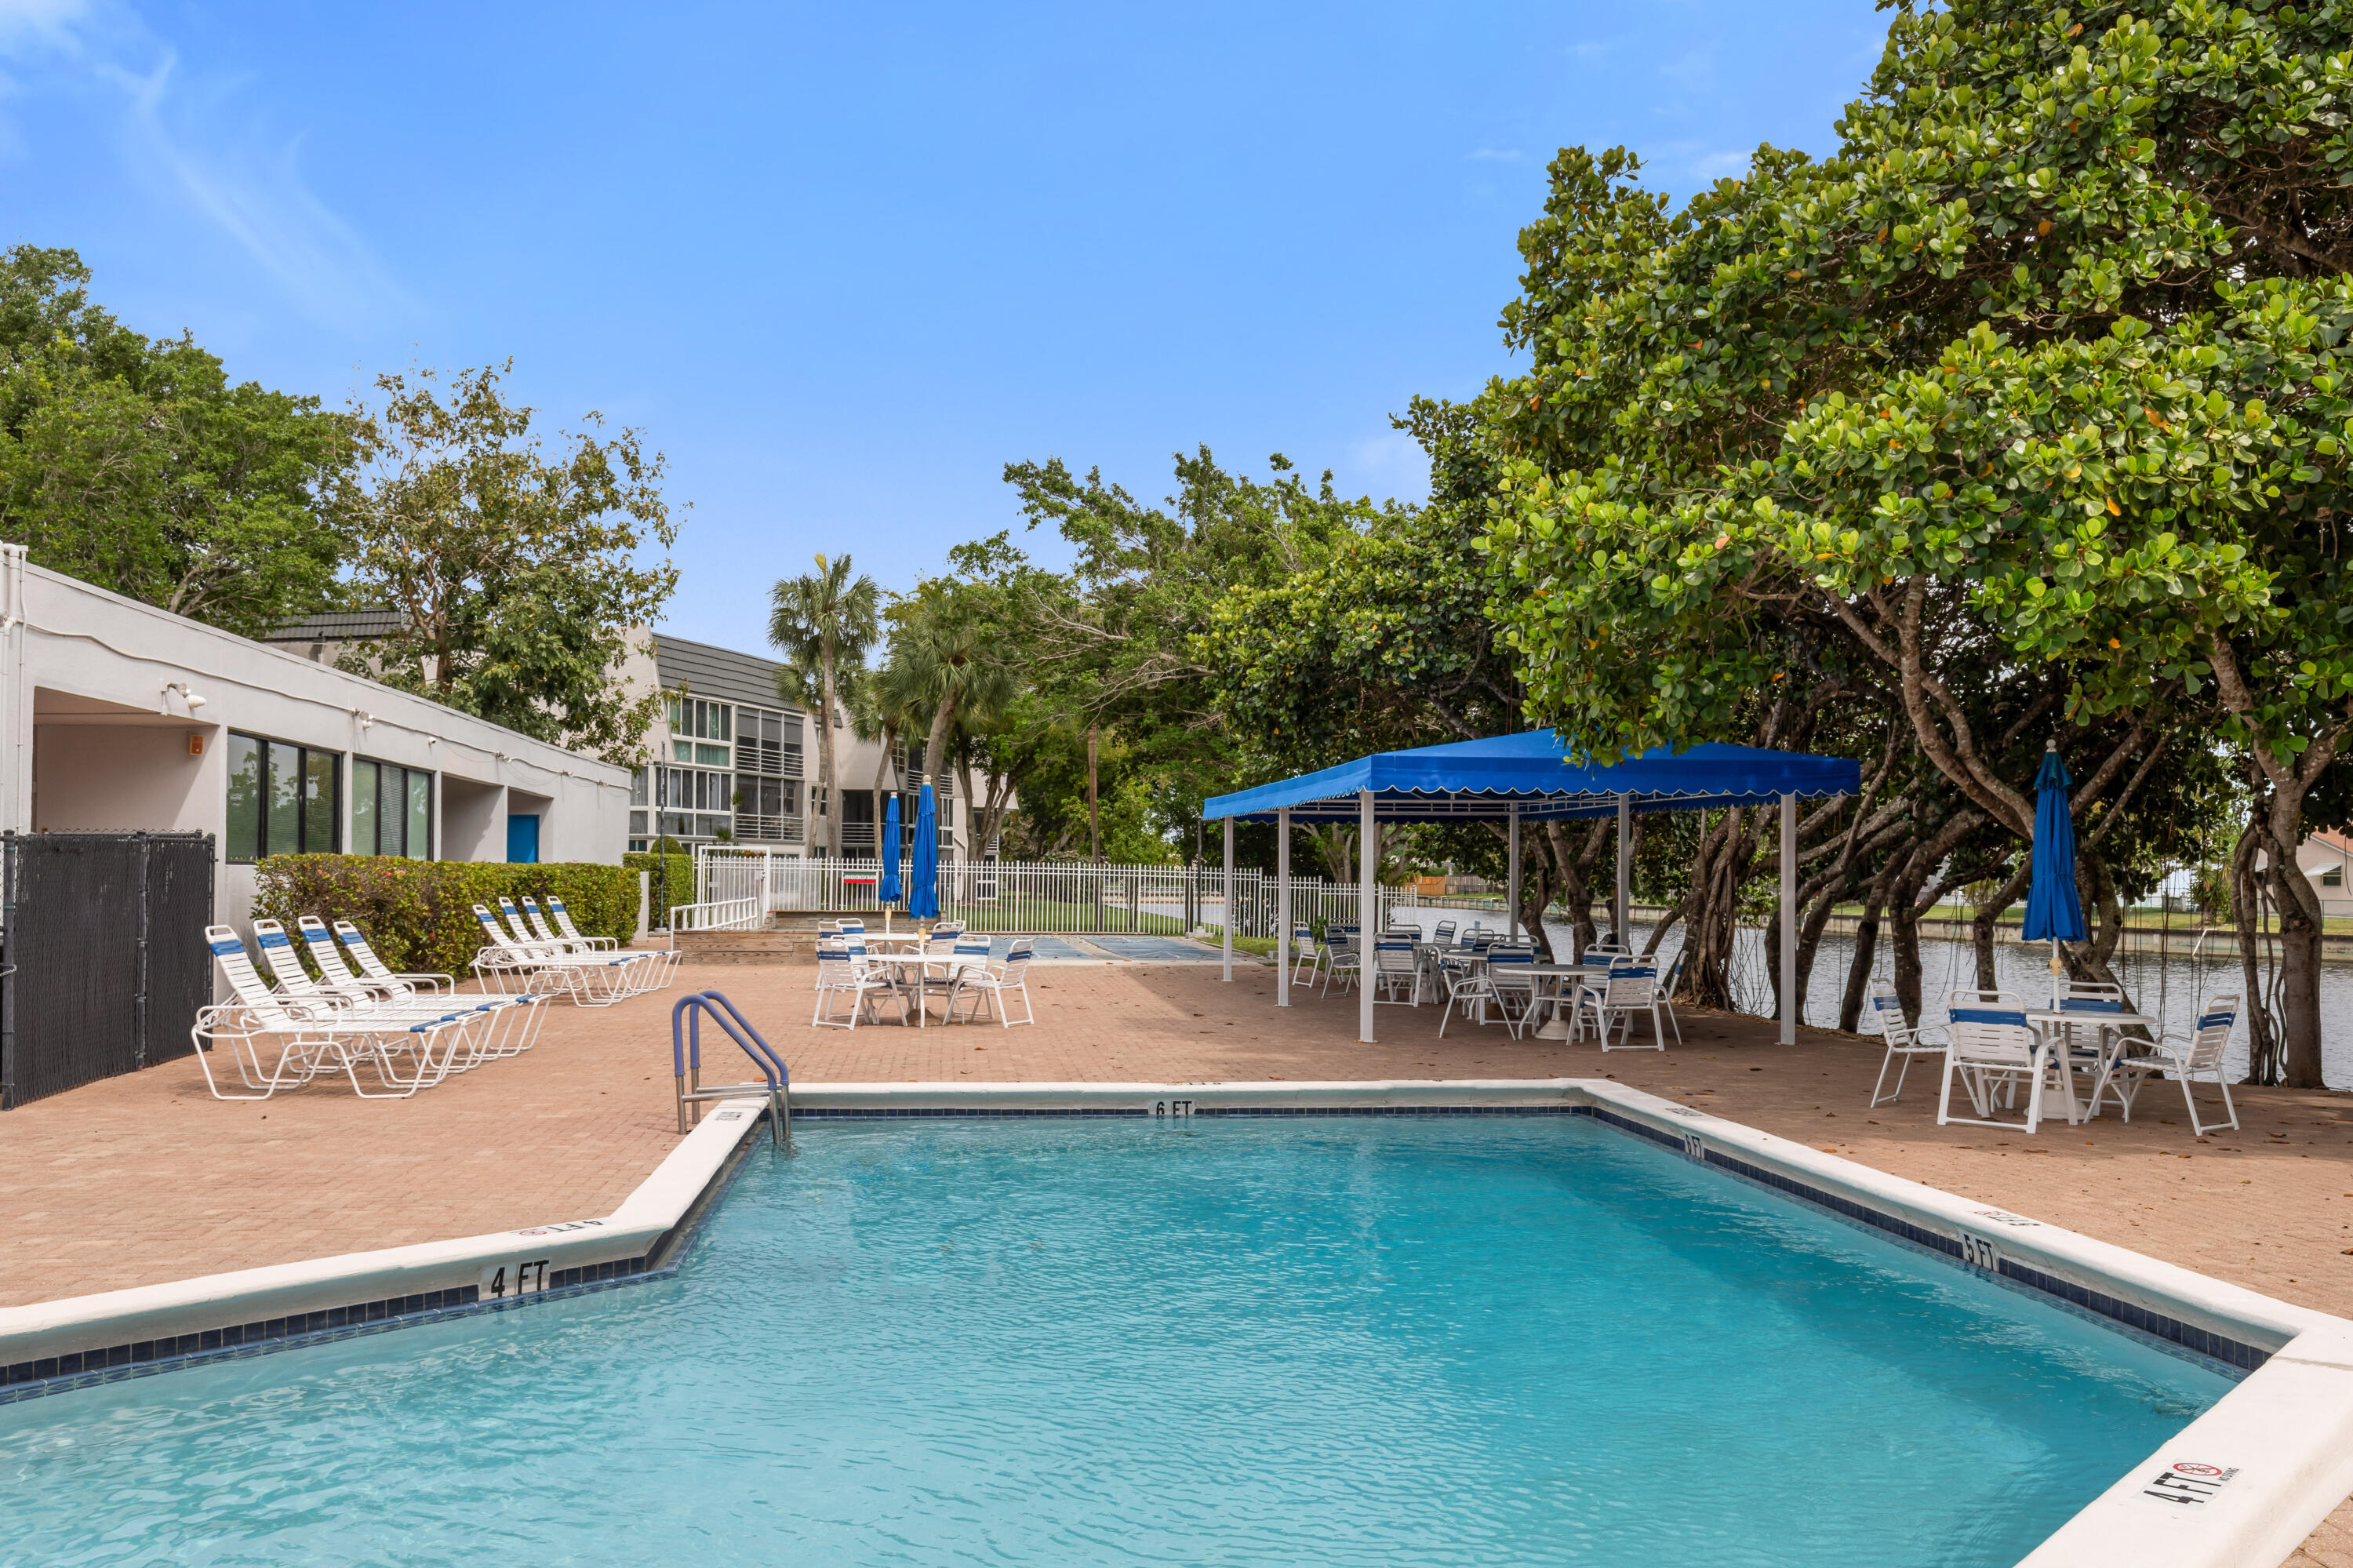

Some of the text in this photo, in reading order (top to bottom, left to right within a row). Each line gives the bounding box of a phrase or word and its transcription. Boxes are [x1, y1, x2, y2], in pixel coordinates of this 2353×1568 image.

[1156, 1101, 1192, 1115] 6 FT
[1686, 1133, 1701, 1159] 6 FT
[546, 1224, 584, 1232] FT
[1963, 1233, 1992, 1271] 5 FT
[491, 1260, 549, 1297] 4 FT
[2143, 1472, 2222, 1504] 4 FT
